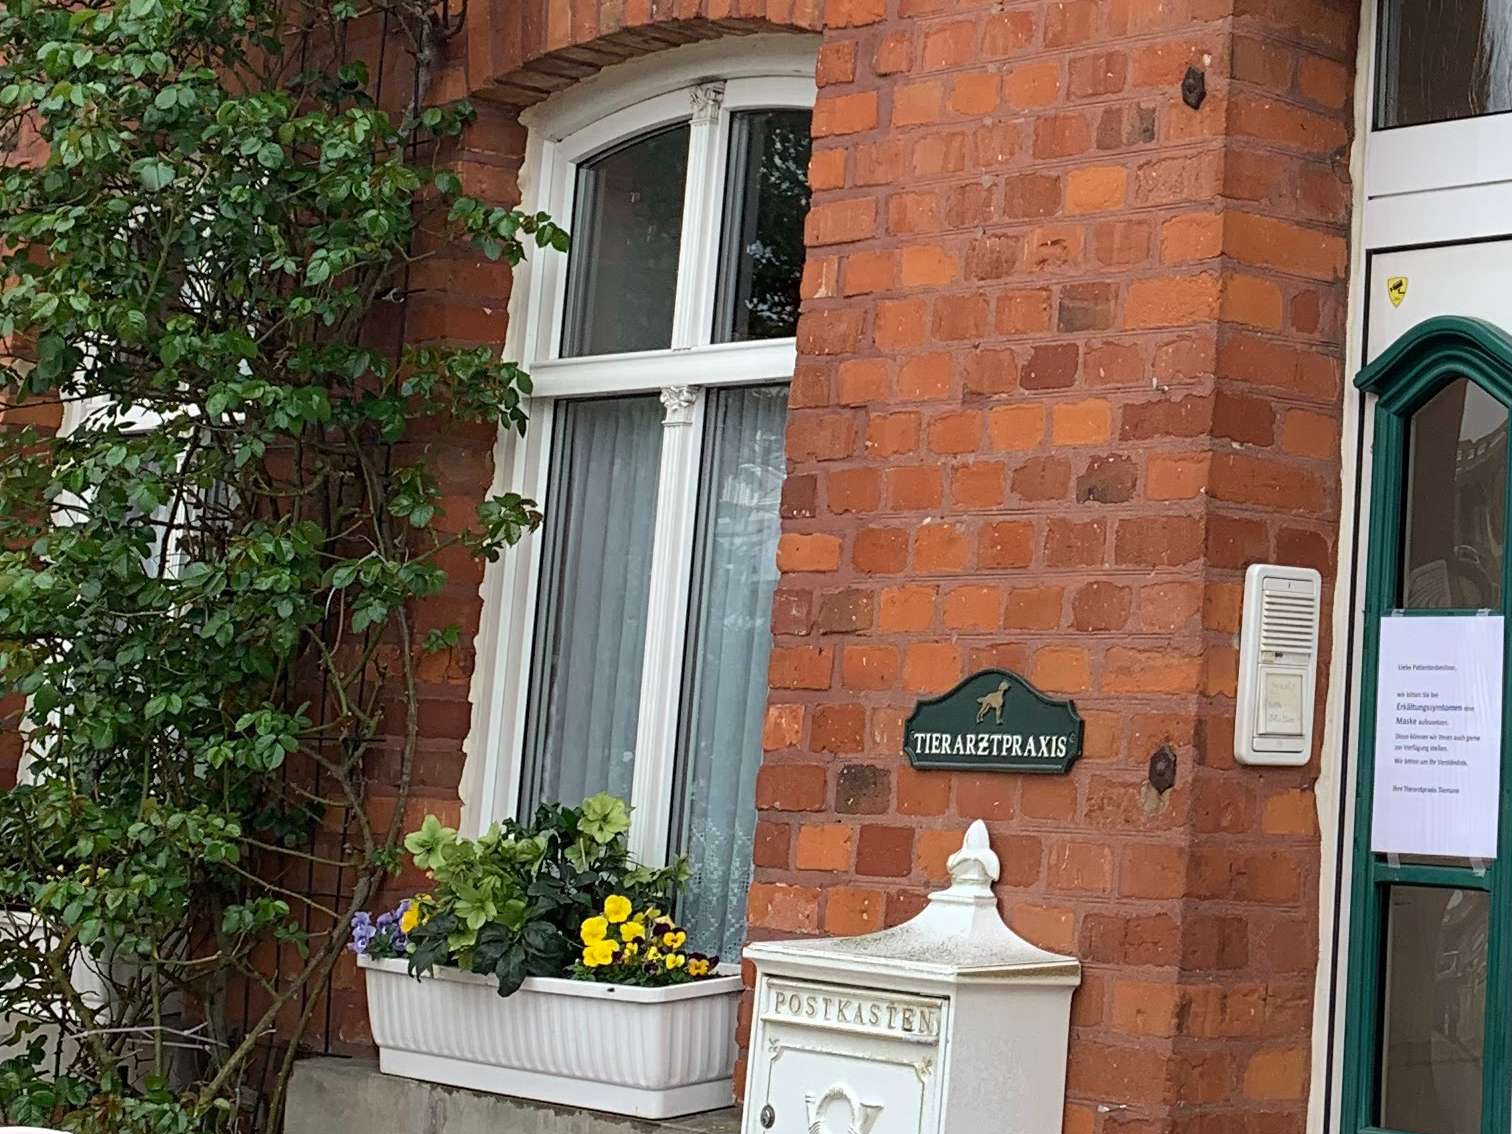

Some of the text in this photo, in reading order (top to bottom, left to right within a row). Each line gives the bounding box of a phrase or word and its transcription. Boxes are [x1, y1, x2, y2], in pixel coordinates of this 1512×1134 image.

[1395, 716, 1417, 726] Maske
[913, 731, 1067, 759] TIERARZTPRAXIS
[774, 990, 937, 1035] POSTKASTEN
